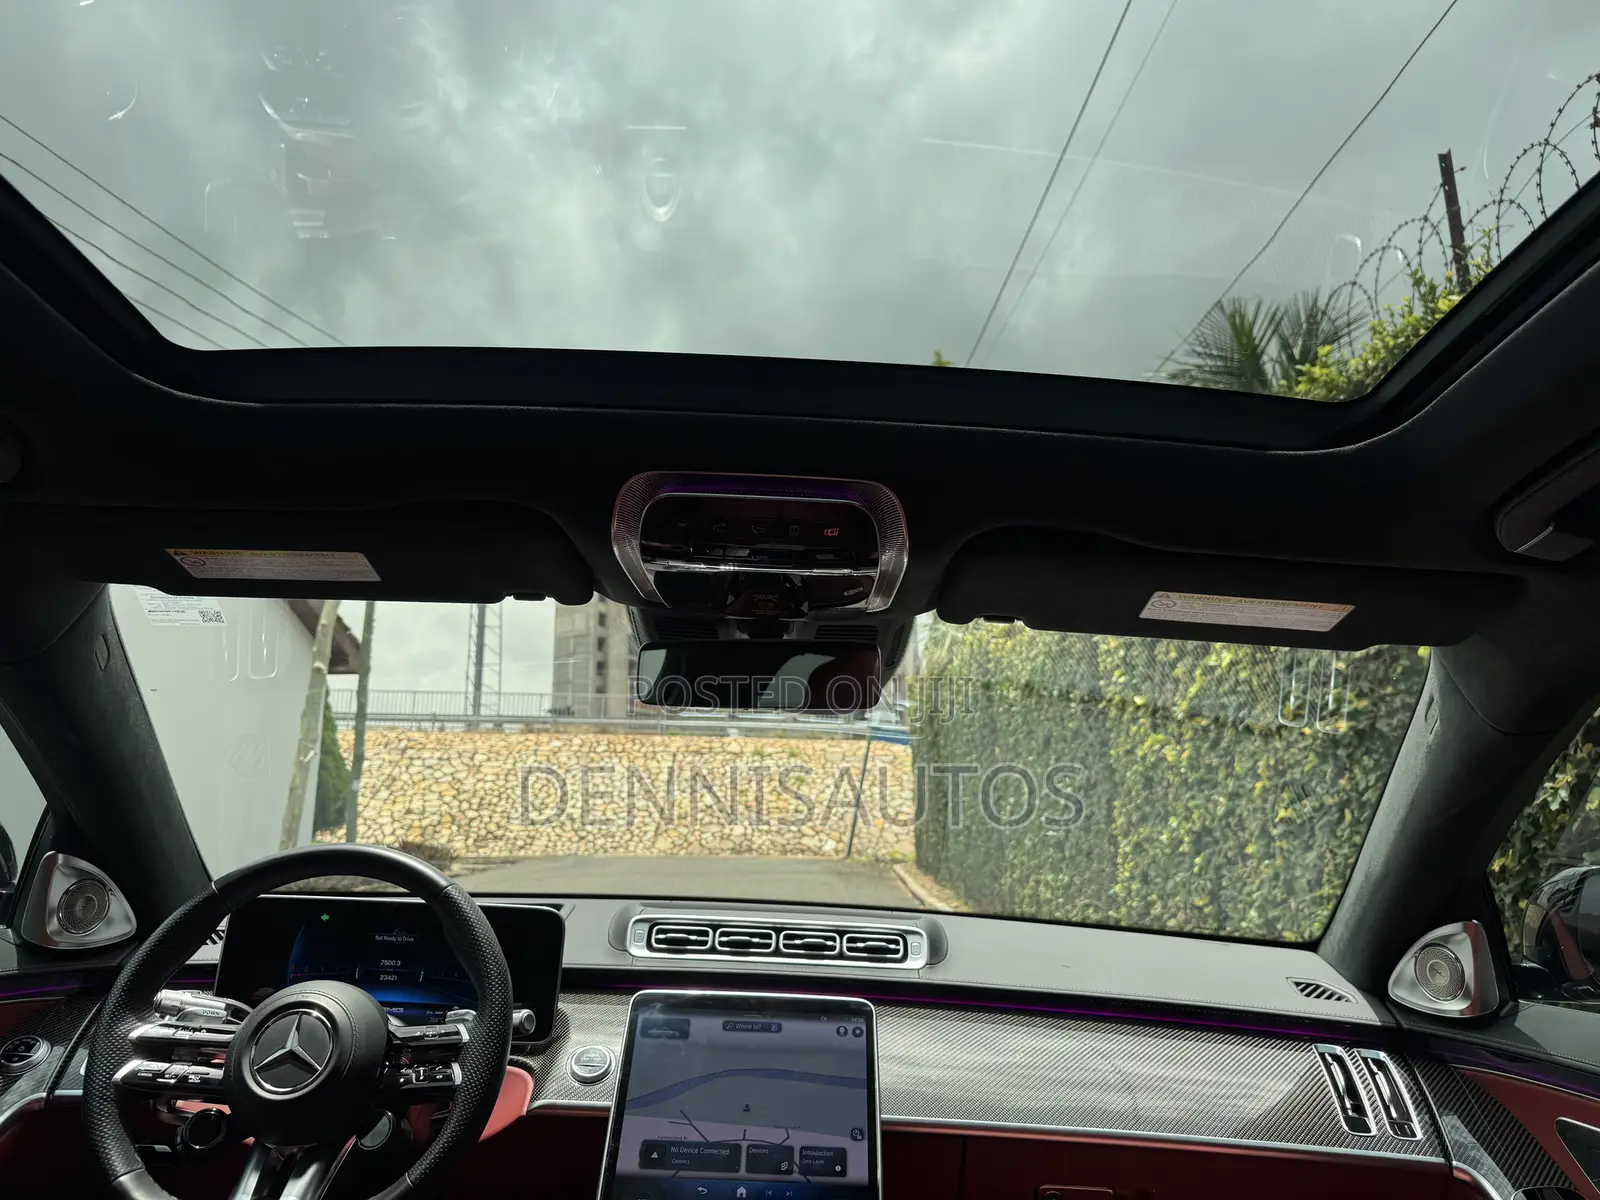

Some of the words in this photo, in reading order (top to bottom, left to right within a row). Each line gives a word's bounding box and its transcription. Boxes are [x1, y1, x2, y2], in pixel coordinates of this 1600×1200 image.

[1178, 594, 1231, 603] WARNING
[384, 935, 397, 943] Ready
[679, 1146, 699, 1154] Device
[699, 1147, 730, 1156] Connected
[748, 1147, 769, 1155] Devices
[801, 1149, 834, 1157] Introduction
[671, 1157, 690, 1165] Connect
